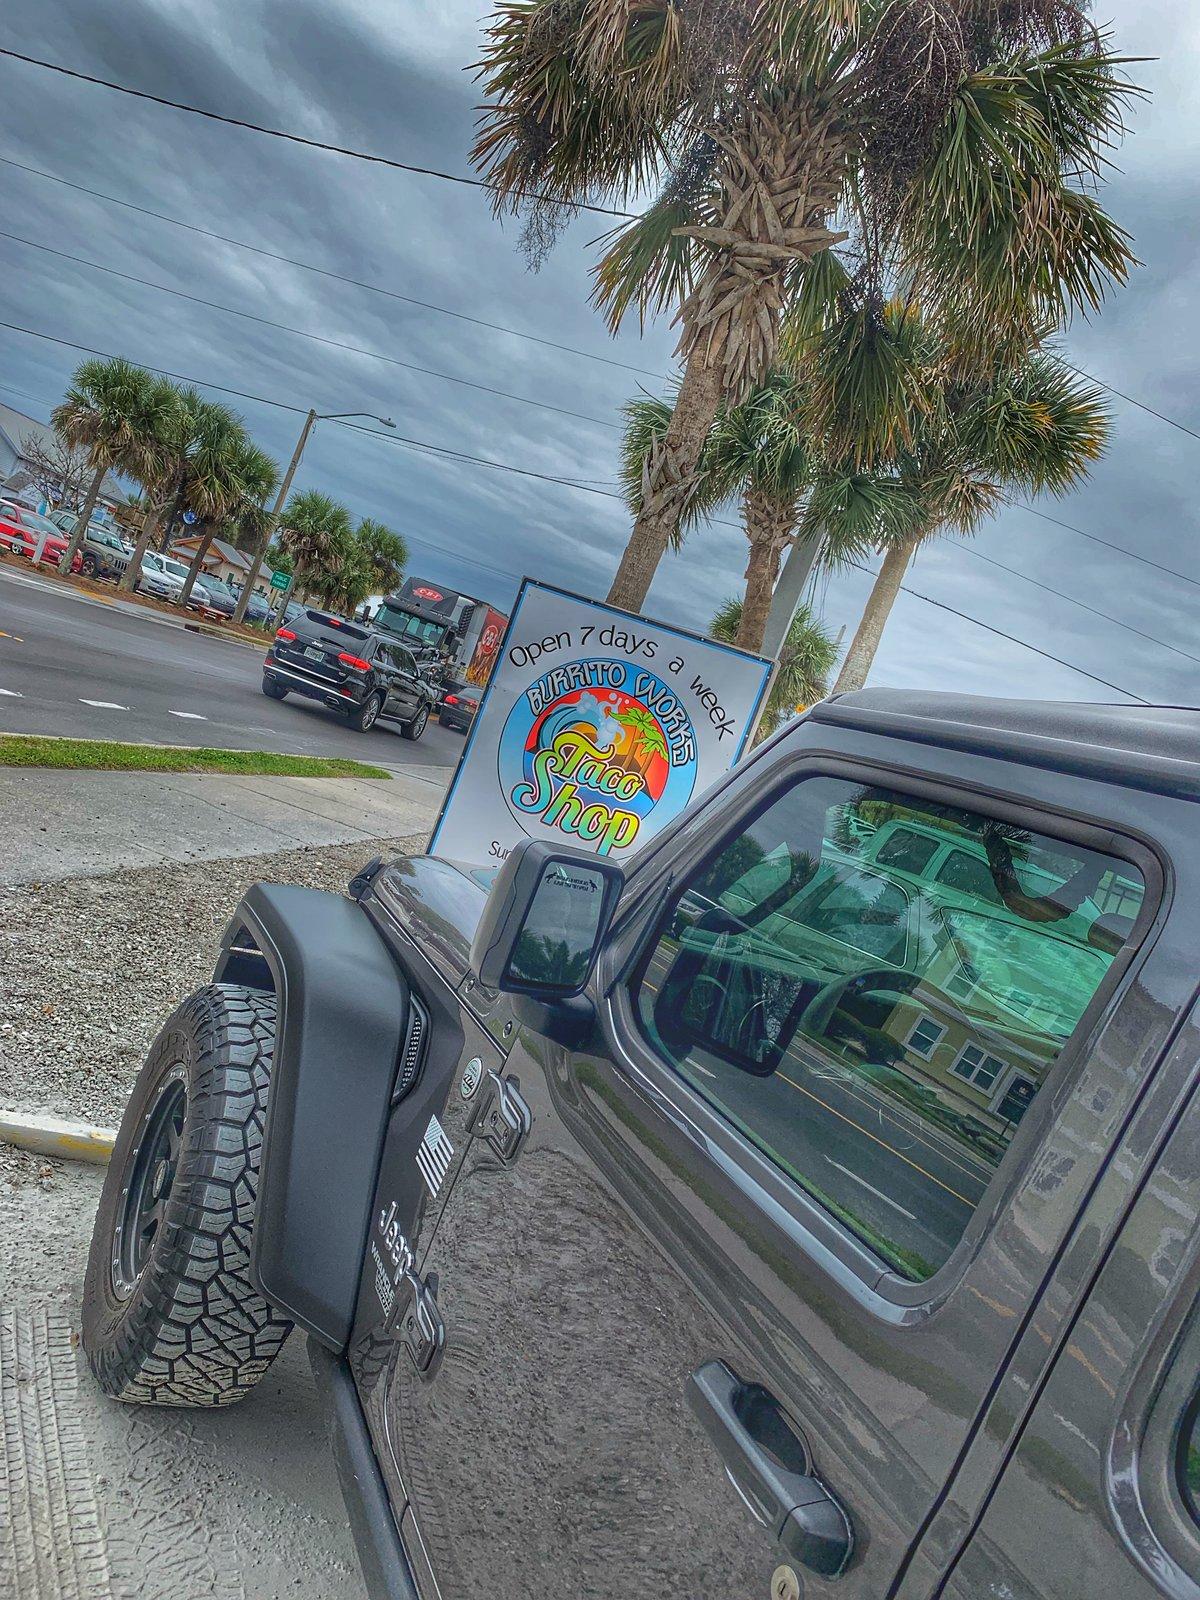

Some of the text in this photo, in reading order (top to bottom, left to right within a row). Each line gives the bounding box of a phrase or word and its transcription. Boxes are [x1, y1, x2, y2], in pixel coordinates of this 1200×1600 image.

[311, 640, 324, 648] Jeep
[509, 625, 737, 741] Open 7 days a week
[526, 661, 696, 768] BURRITO WORKS
[510, 748, 641, 856] Shop
[550, 730, 645, 801] Taco
[379, 1200, 411, 1286] Jeep
